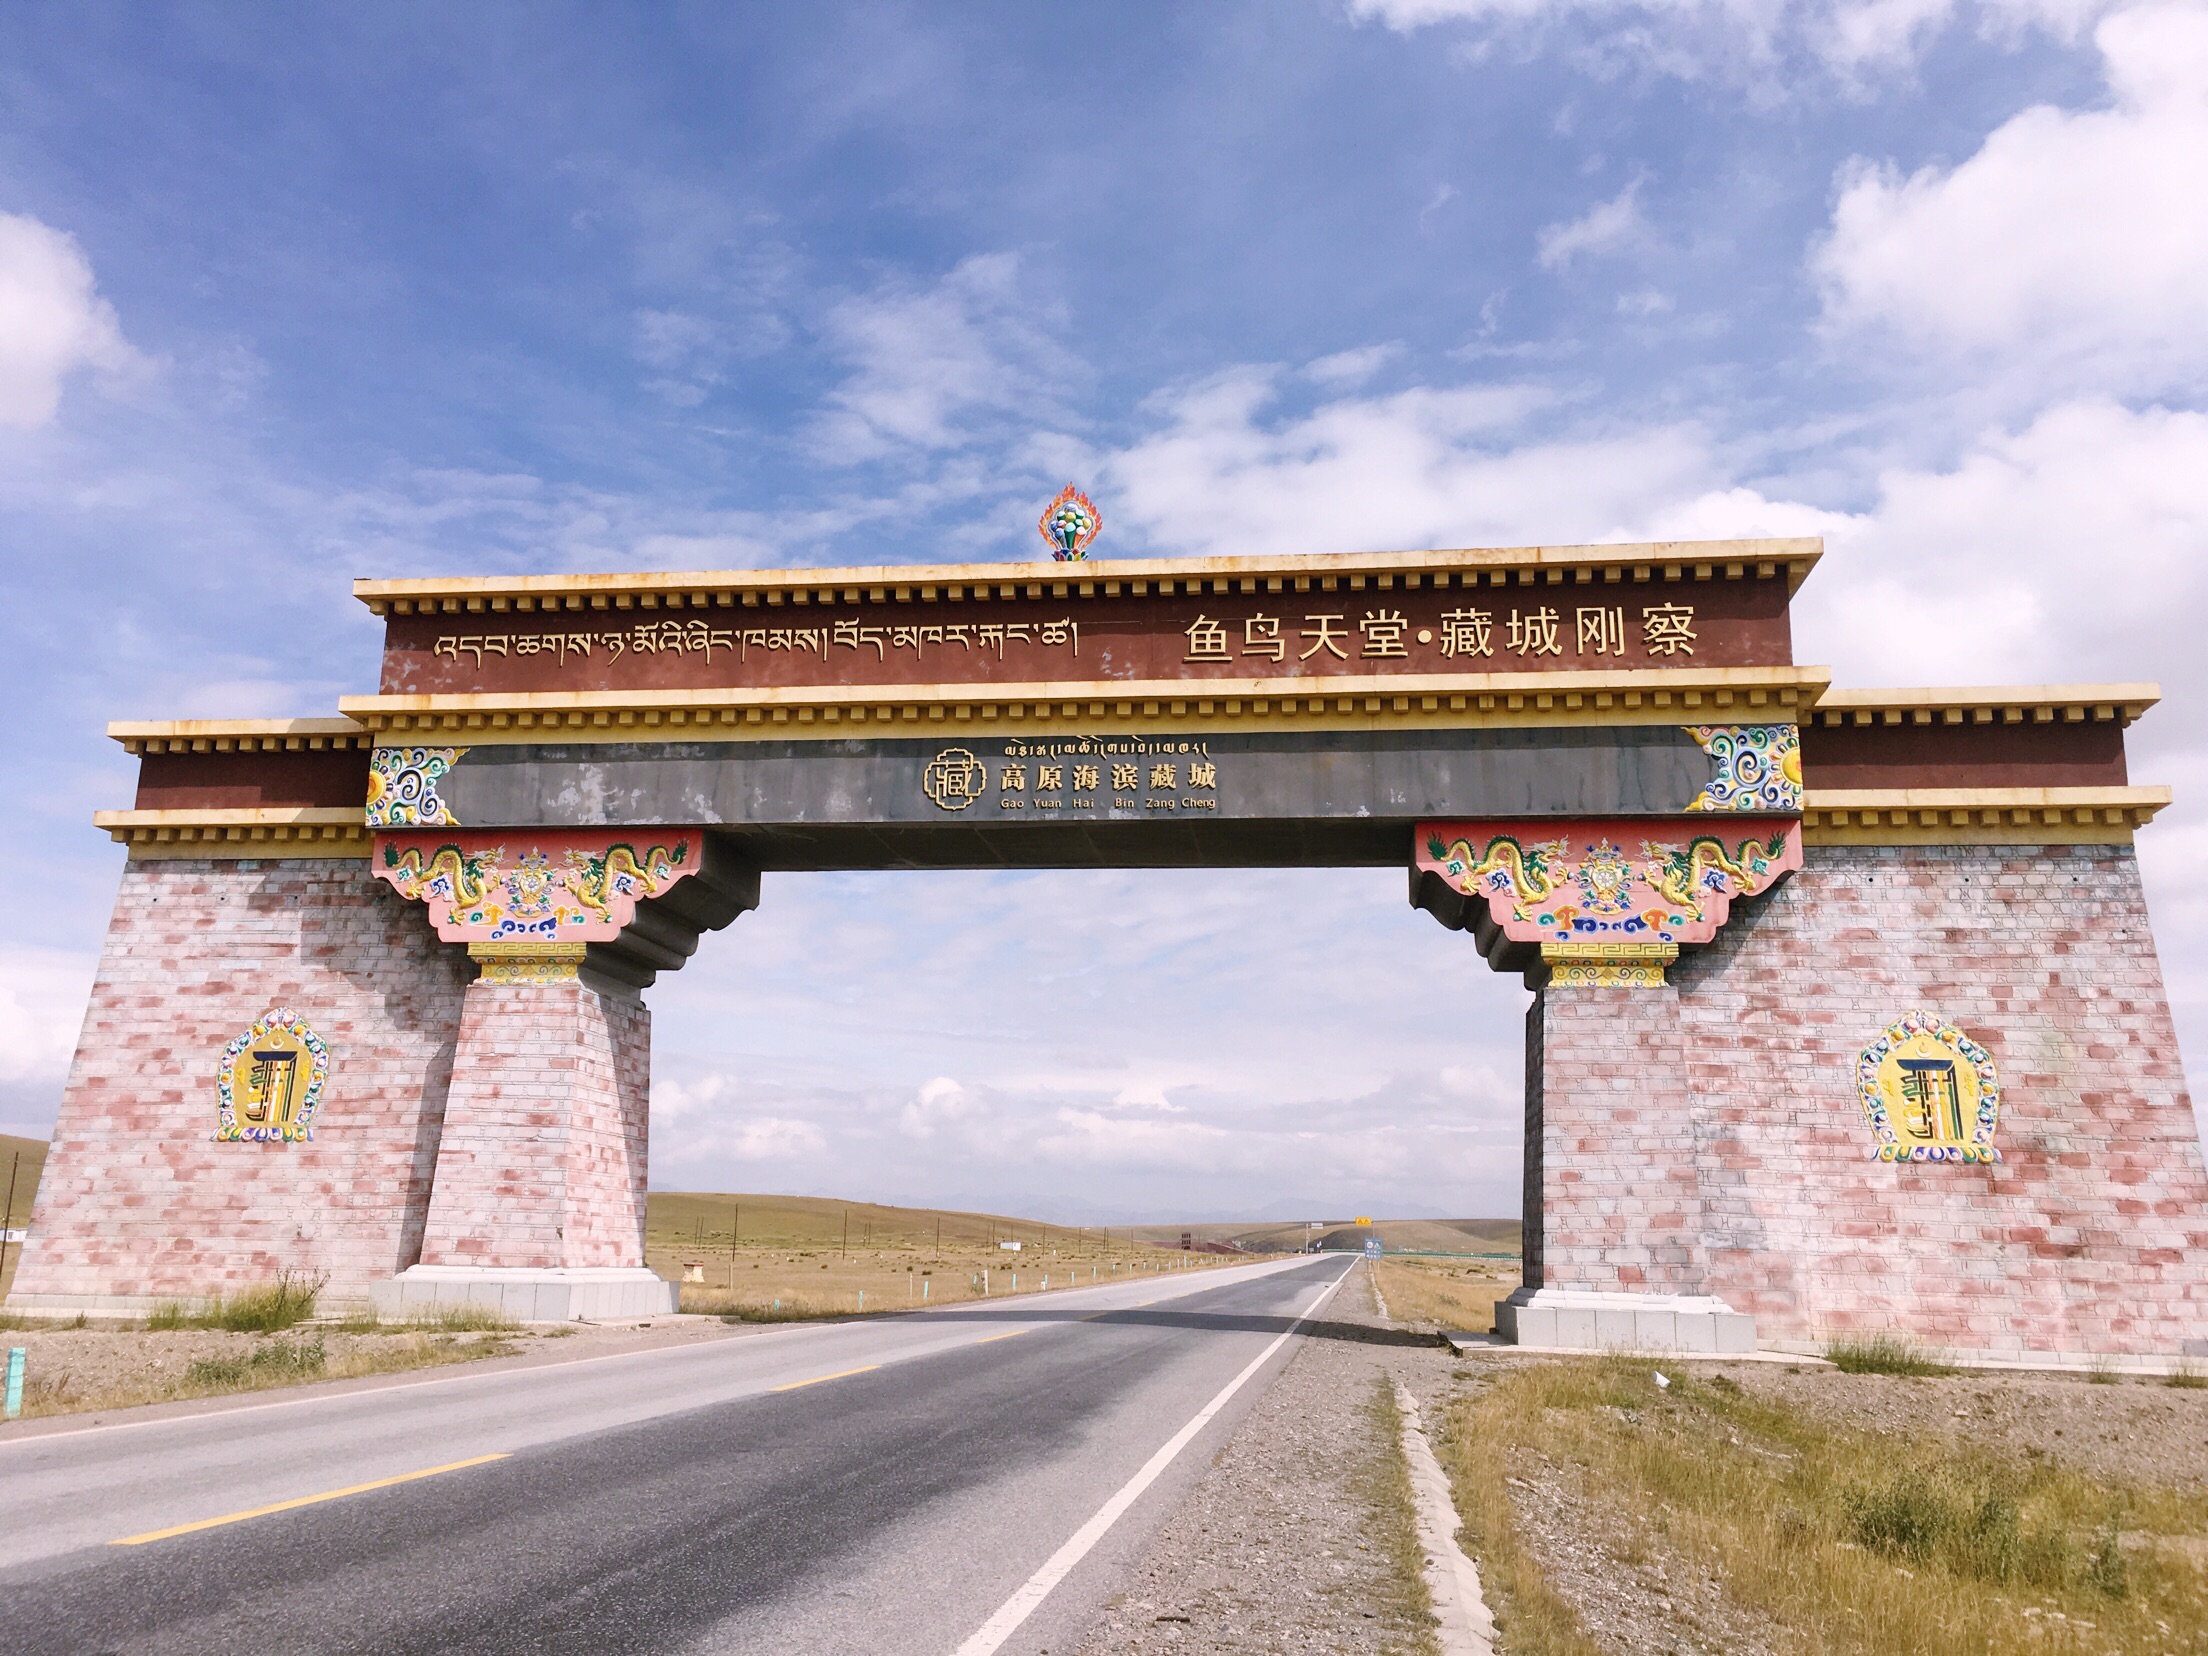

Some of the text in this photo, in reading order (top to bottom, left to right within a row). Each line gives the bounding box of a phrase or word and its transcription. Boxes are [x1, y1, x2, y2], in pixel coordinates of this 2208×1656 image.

[1001, 763, 1216, 791] 高原海滨藏城
[1000, 796, 1216, 810] Gao Yuan Hai Bin Zang Cheng
